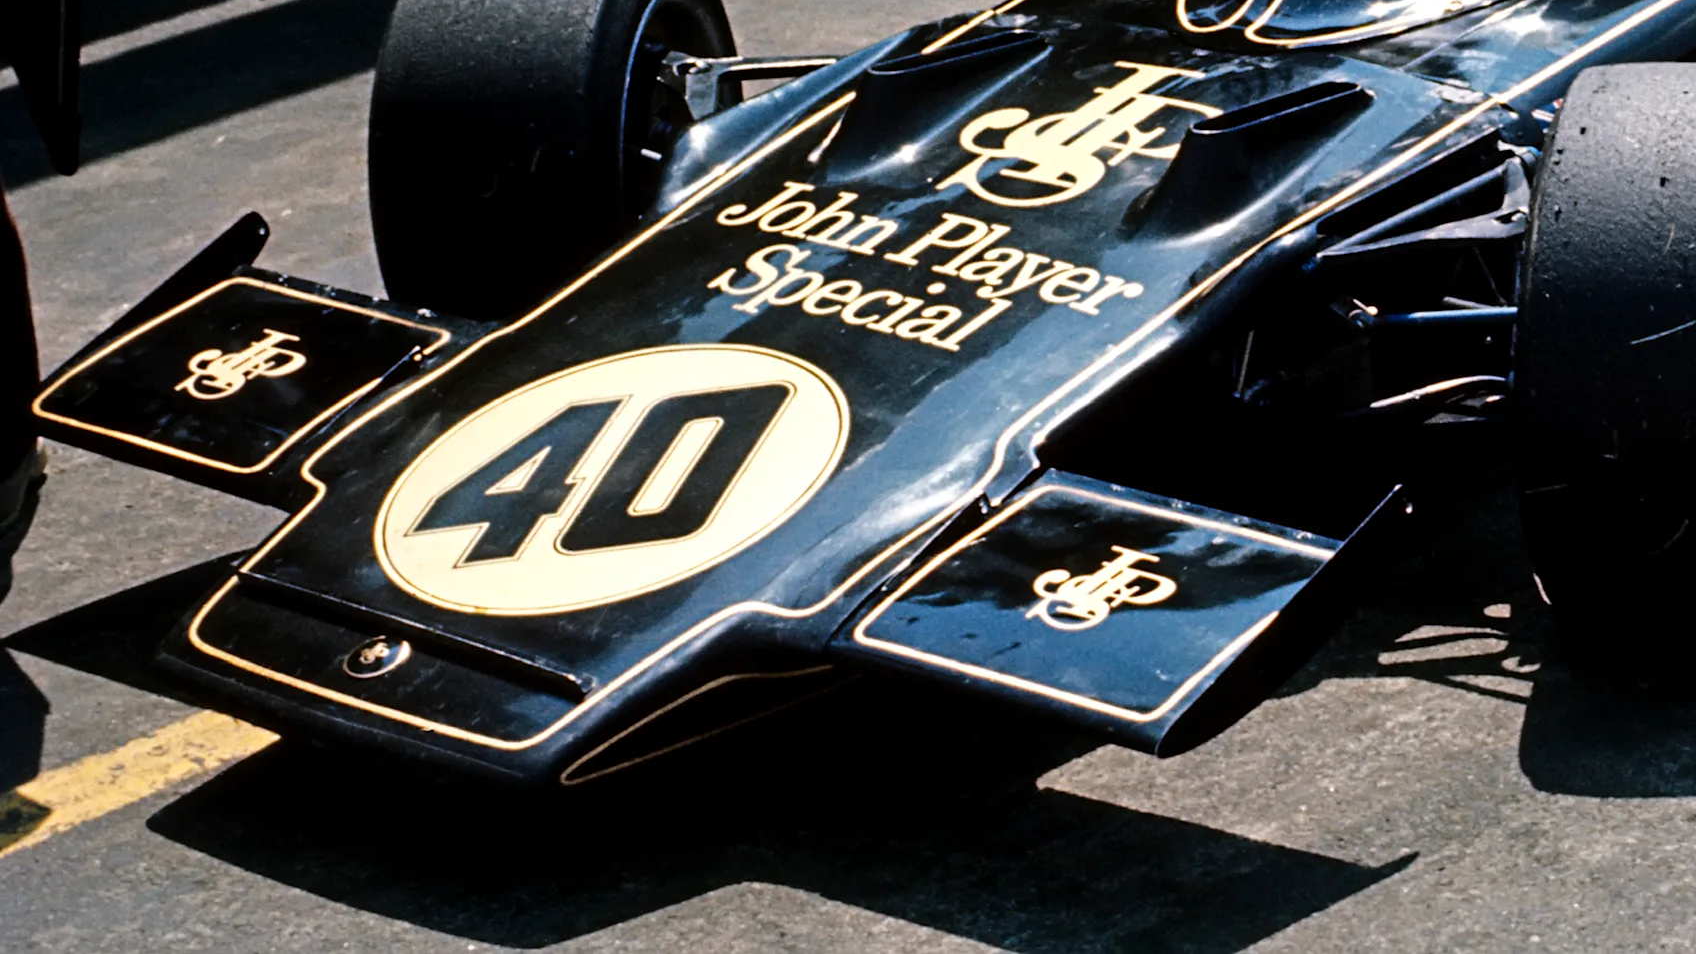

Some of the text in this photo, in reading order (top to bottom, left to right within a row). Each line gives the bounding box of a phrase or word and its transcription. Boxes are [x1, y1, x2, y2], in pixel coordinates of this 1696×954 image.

[707, 243, 1013, 352] Special
[716, 181, 1143, 316] John Player
[404, 380, 797, 569] 40
